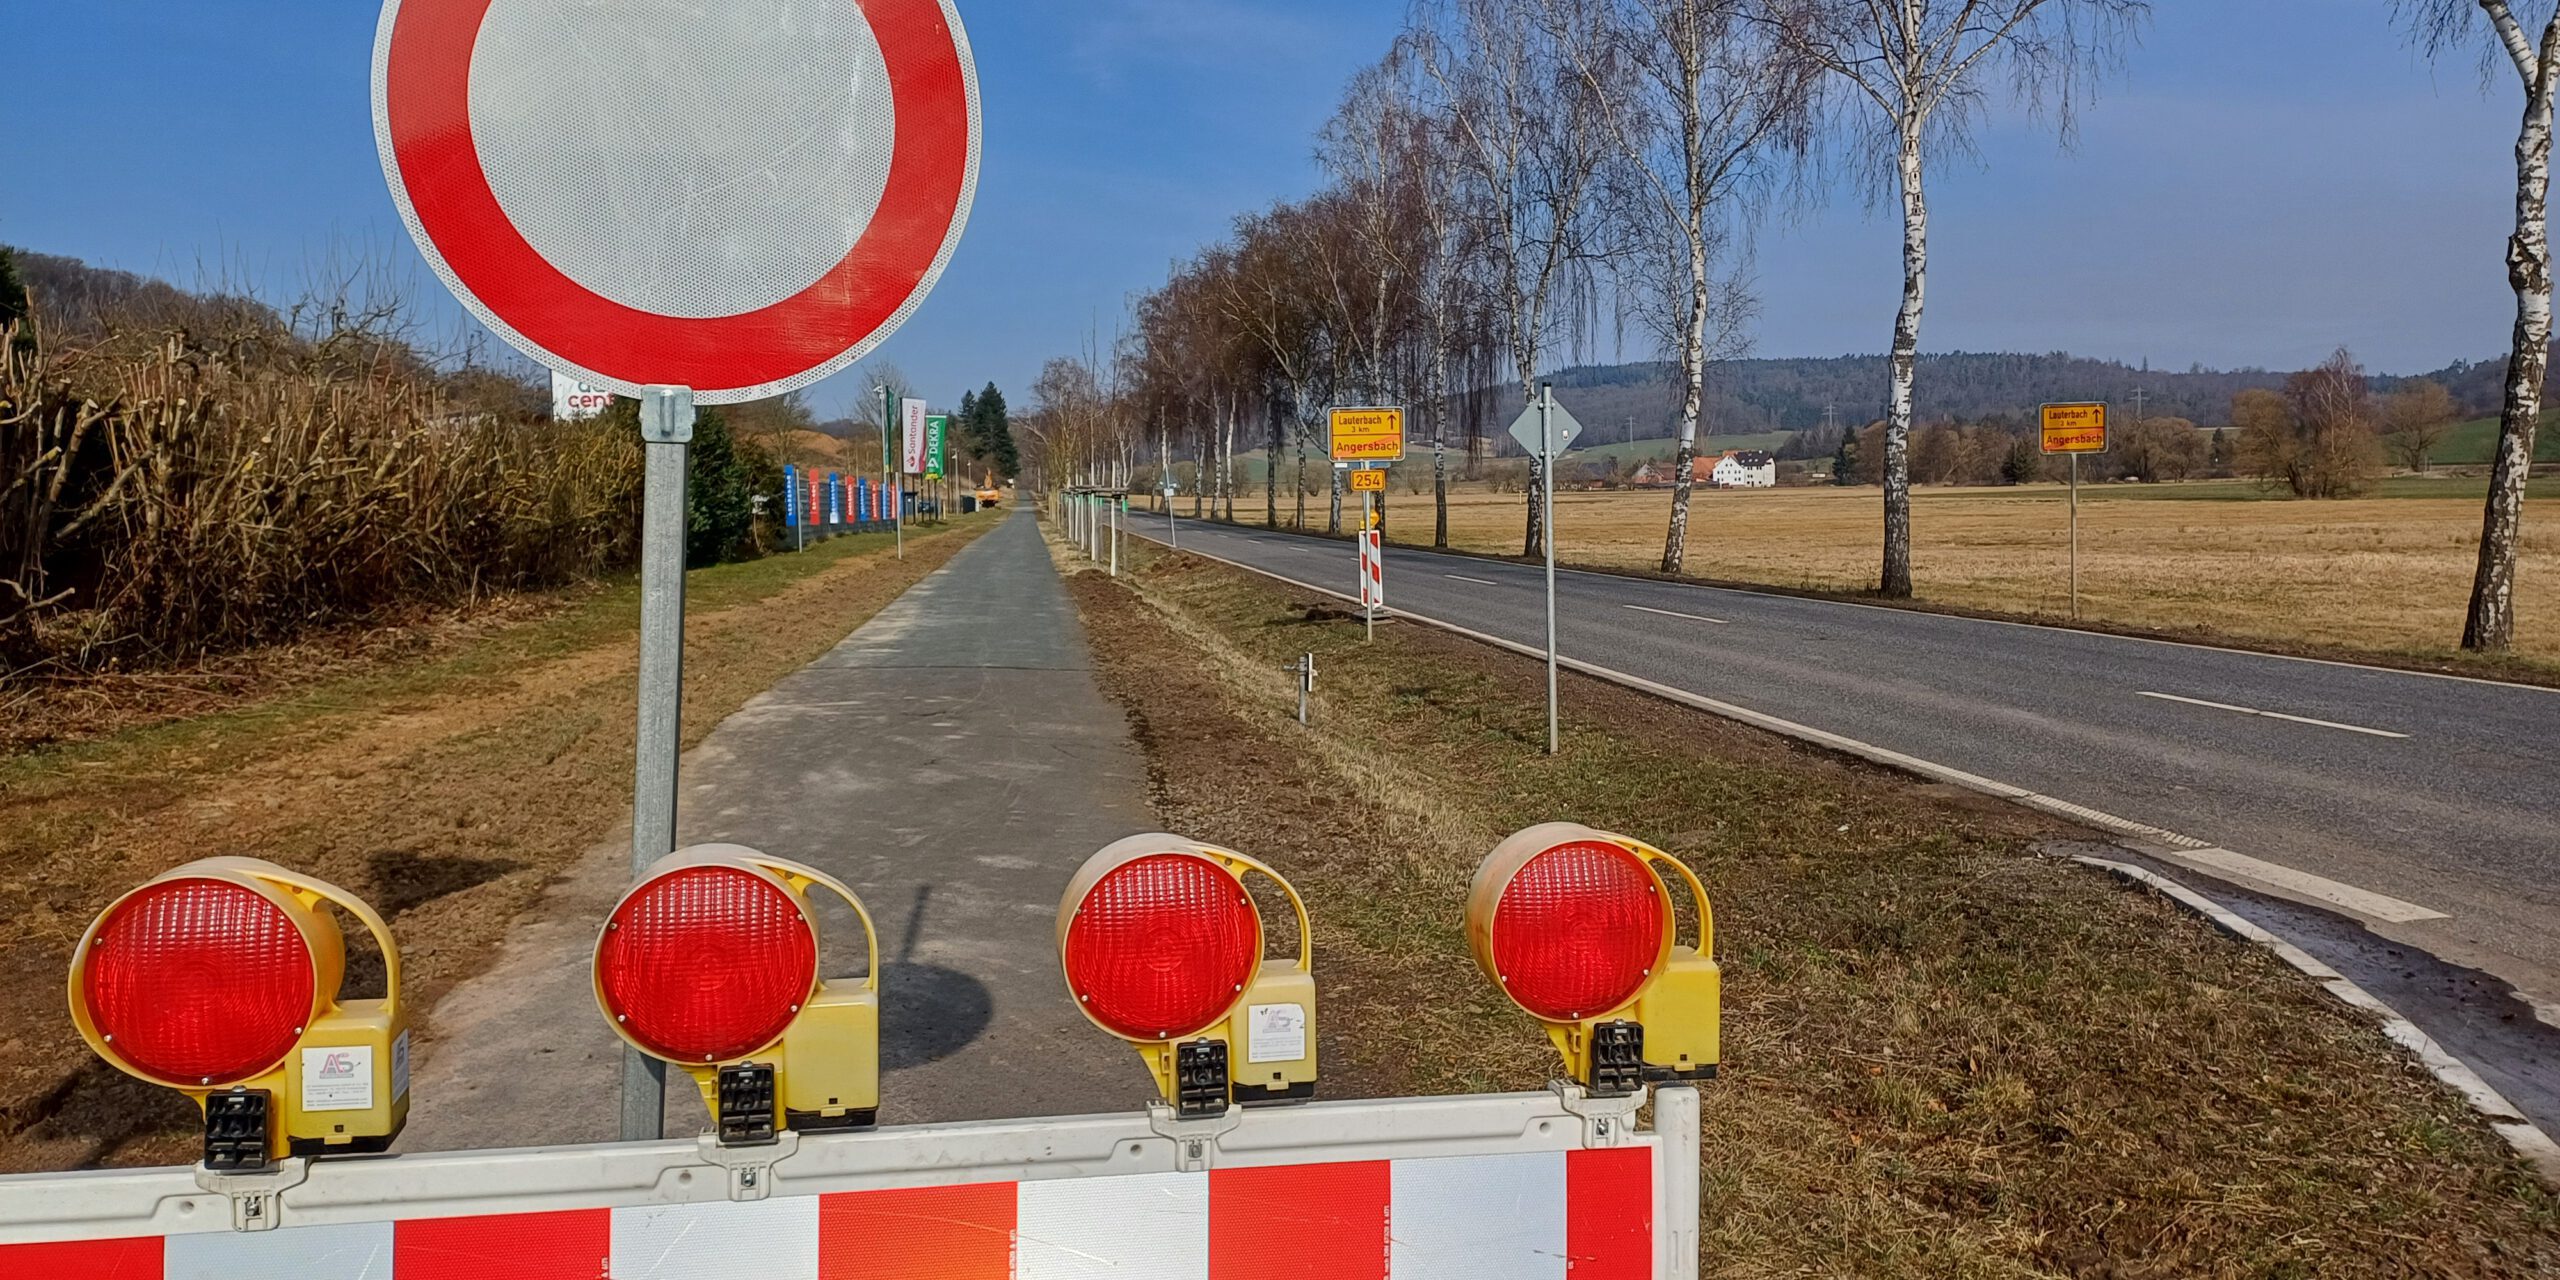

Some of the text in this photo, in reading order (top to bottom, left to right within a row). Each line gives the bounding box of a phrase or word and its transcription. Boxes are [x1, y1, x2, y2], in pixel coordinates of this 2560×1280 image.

[1338, 415, 1382, 425] Lauterbach
[2049, 410, 2088, 419] Lauterbach
[909, 405, 918, 454] Santander
[929, 421, 940, 454] DEKRA
[2047, 433, 2102, 446] Angersbach
[1336, 441, 1399, 454] Angersbach
[1356, 474, 1380, 487] 254
[322, 1052, 354, 1073] AS
